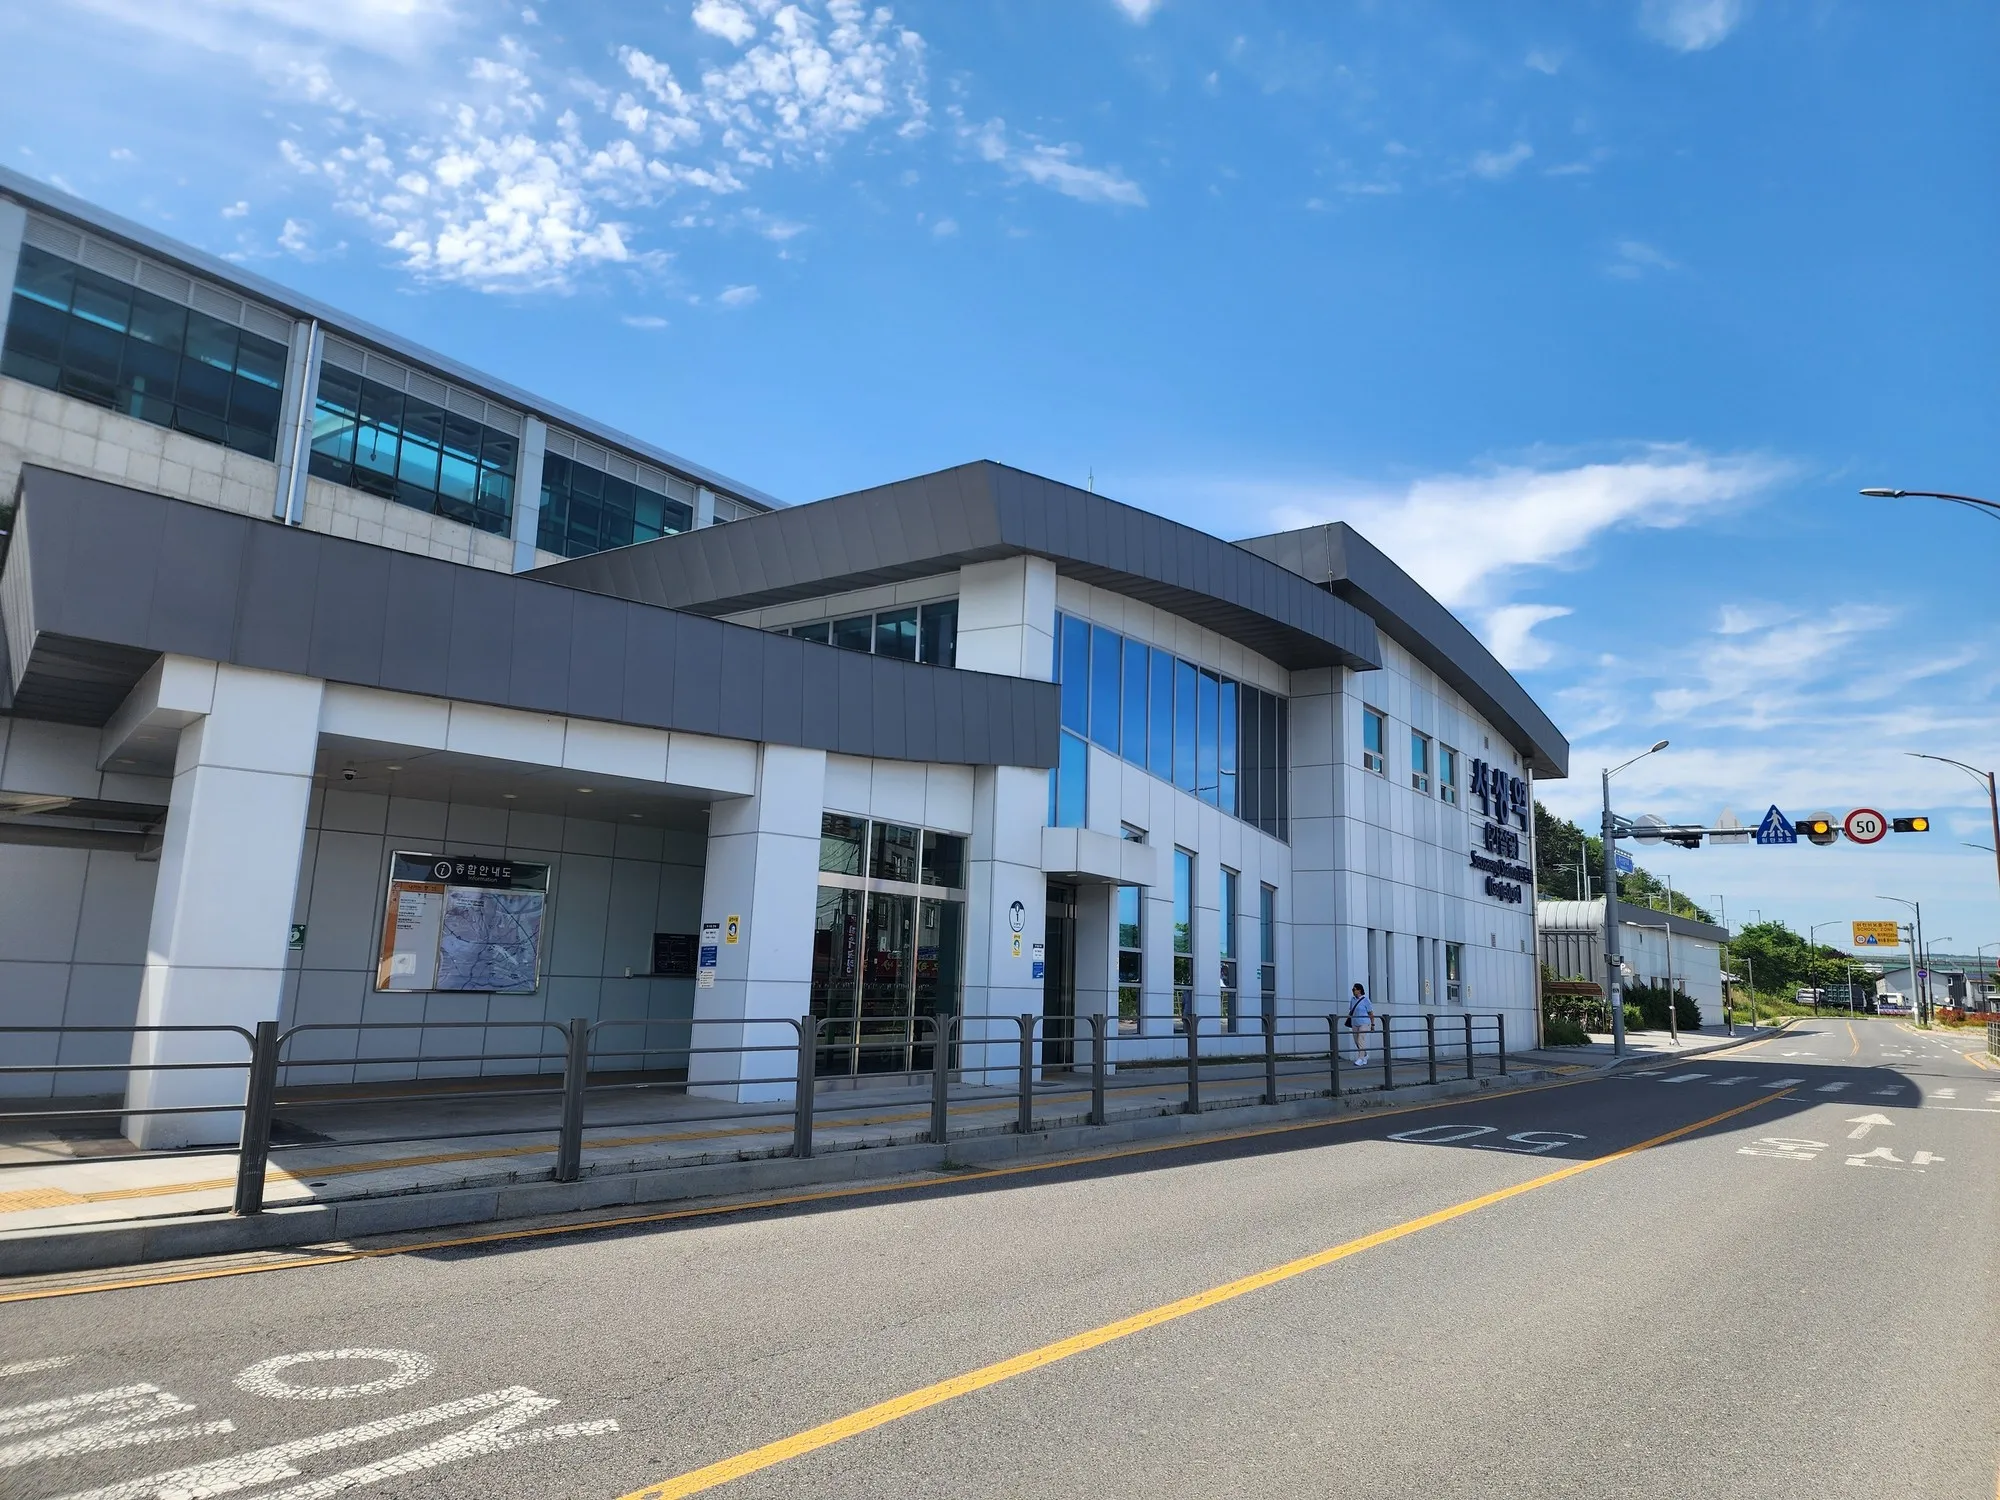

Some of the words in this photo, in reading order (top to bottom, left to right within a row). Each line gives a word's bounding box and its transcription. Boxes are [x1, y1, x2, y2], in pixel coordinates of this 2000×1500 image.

[1470, 759, 1527, 832] 서생역
[1856, 820, 1875, 834] 50
[456, 863, 511, 878] 종합안내도
[1386, 1124, 1587, 1154] 50
[1735, 1137, 1946, 1173] 울산
